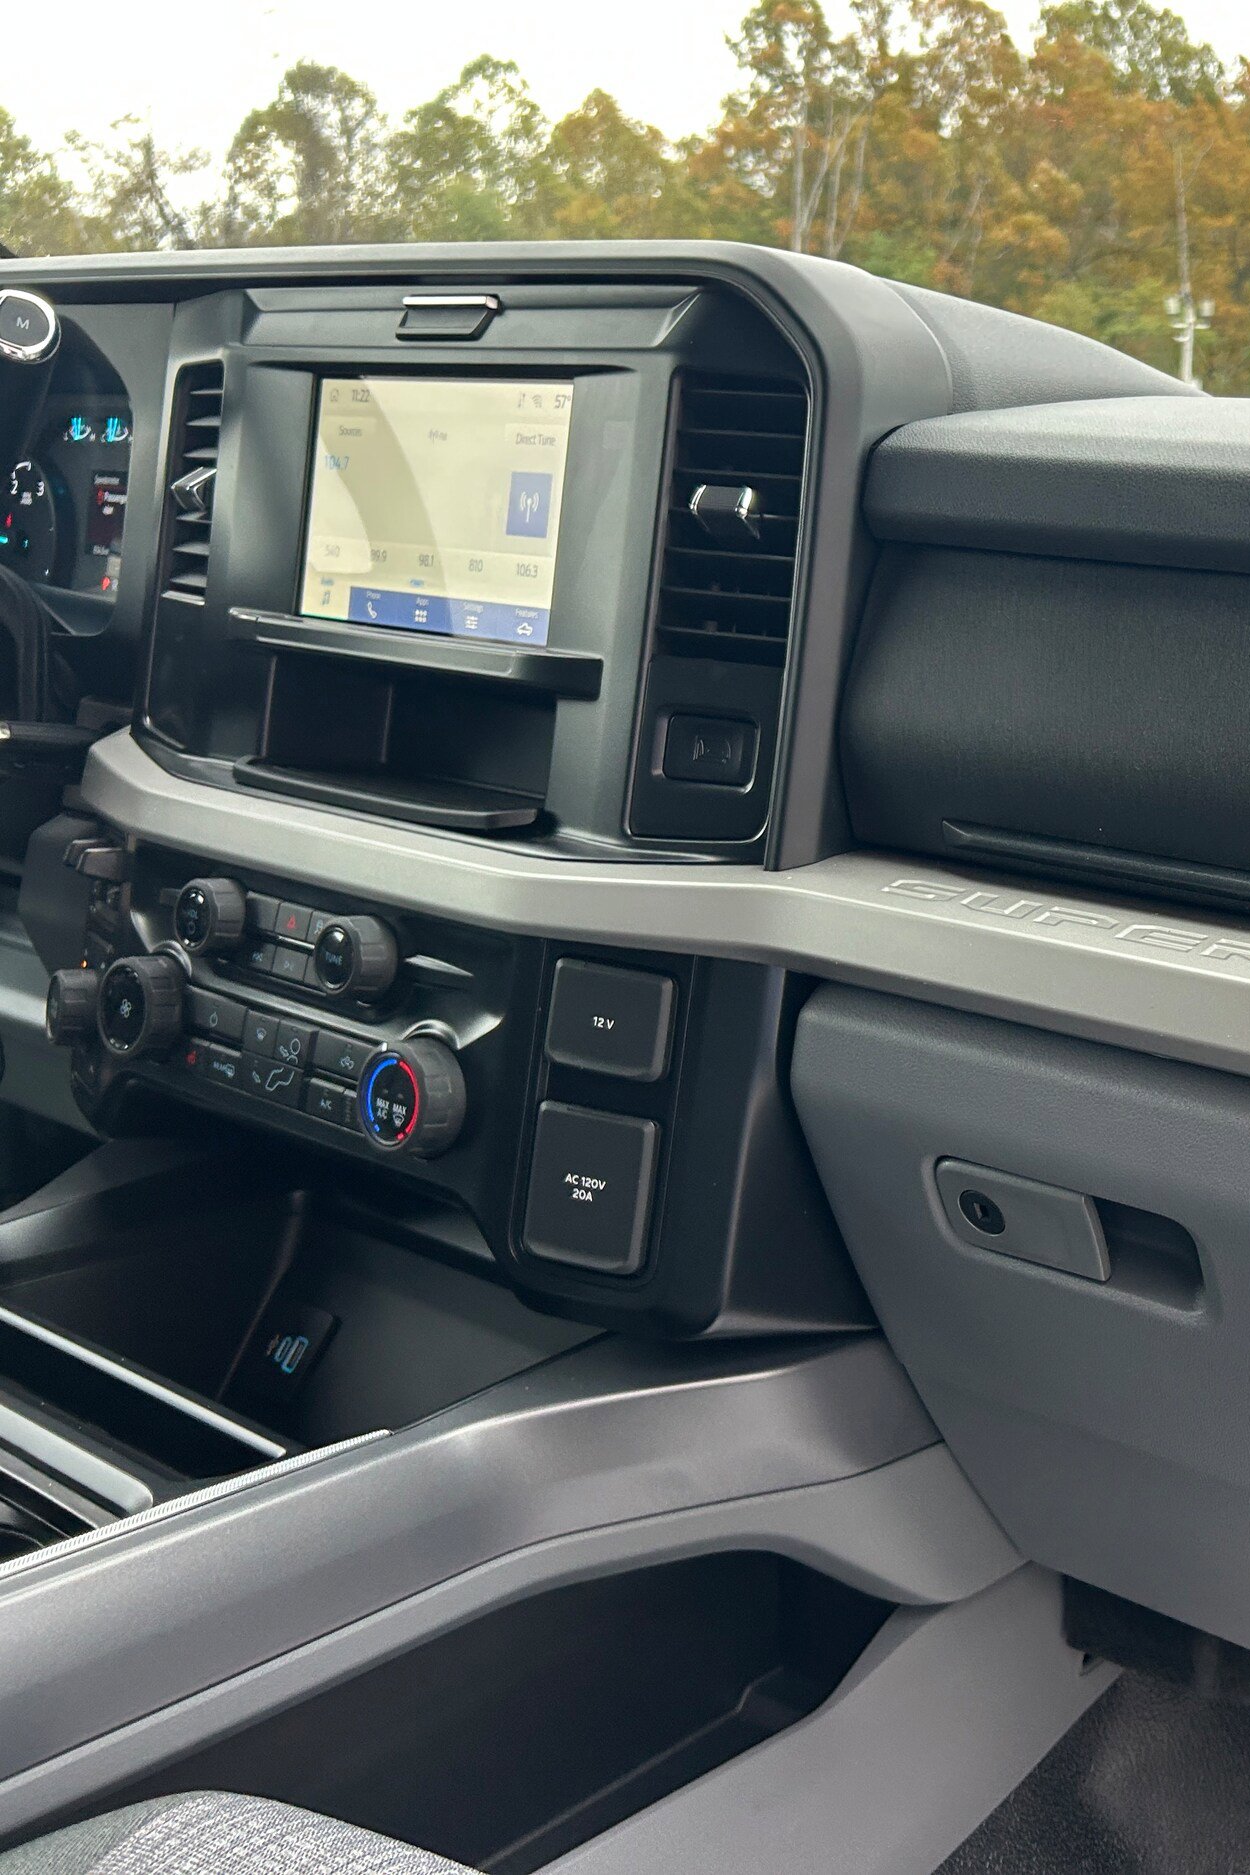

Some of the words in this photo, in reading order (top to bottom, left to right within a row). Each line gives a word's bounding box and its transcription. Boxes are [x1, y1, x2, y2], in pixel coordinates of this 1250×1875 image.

[16, 317, 30, 330] M
[516, 563, 539, 578] 106.3
[592, 1016, 604, 1028] 12
[606, 1019, 615, 1030] V
[376, 1097, 389, 1110] MAX
[392, 1103, 407, 1116] MAX
[564, 1172, 579, 1186] AC
[581, 1176, 606, 1191] 120V
[572, 1188, 593, 1202] 20A
